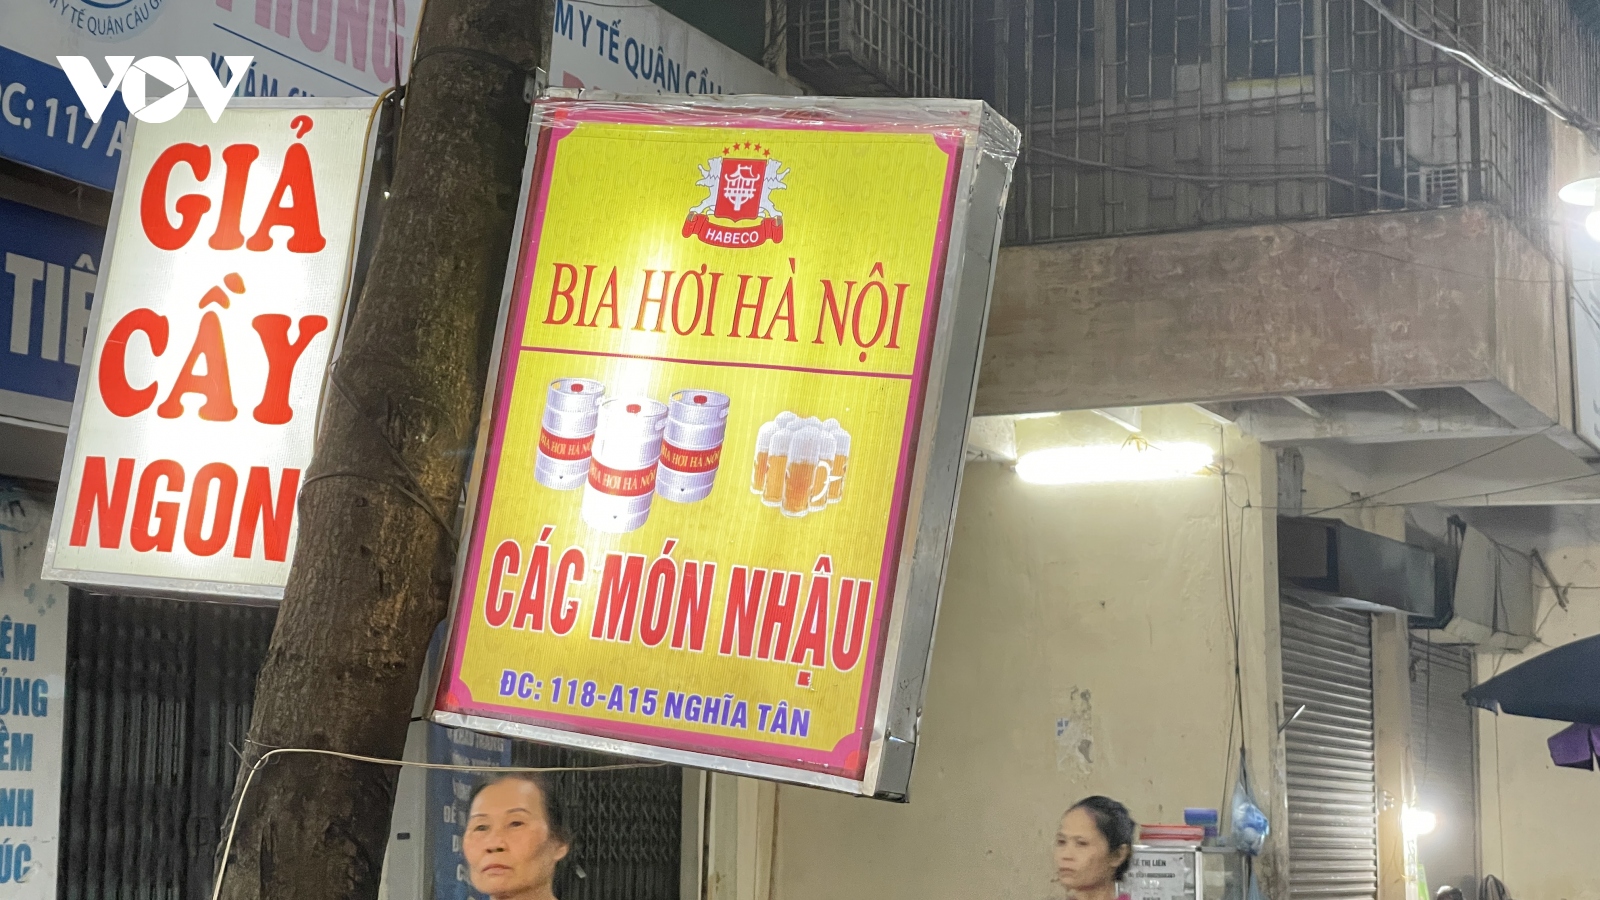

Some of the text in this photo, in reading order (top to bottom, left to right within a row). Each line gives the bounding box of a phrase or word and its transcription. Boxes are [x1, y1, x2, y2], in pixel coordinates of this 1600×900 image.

[140, 114, 327, 253] GIẢ
[705, 227, 759, 244] HABECO
[98, 271, 329, 426] CẦY
[542, 257, 911, 363] BIA HƠI HÀ NỘI
[68, 455, 302, 563] NGON
[484, 525, 873, 688] CÁC MÓN NHẬU
[499, 669, 812, 738] ĐC: 118-A15 NGHĨA TÂN
